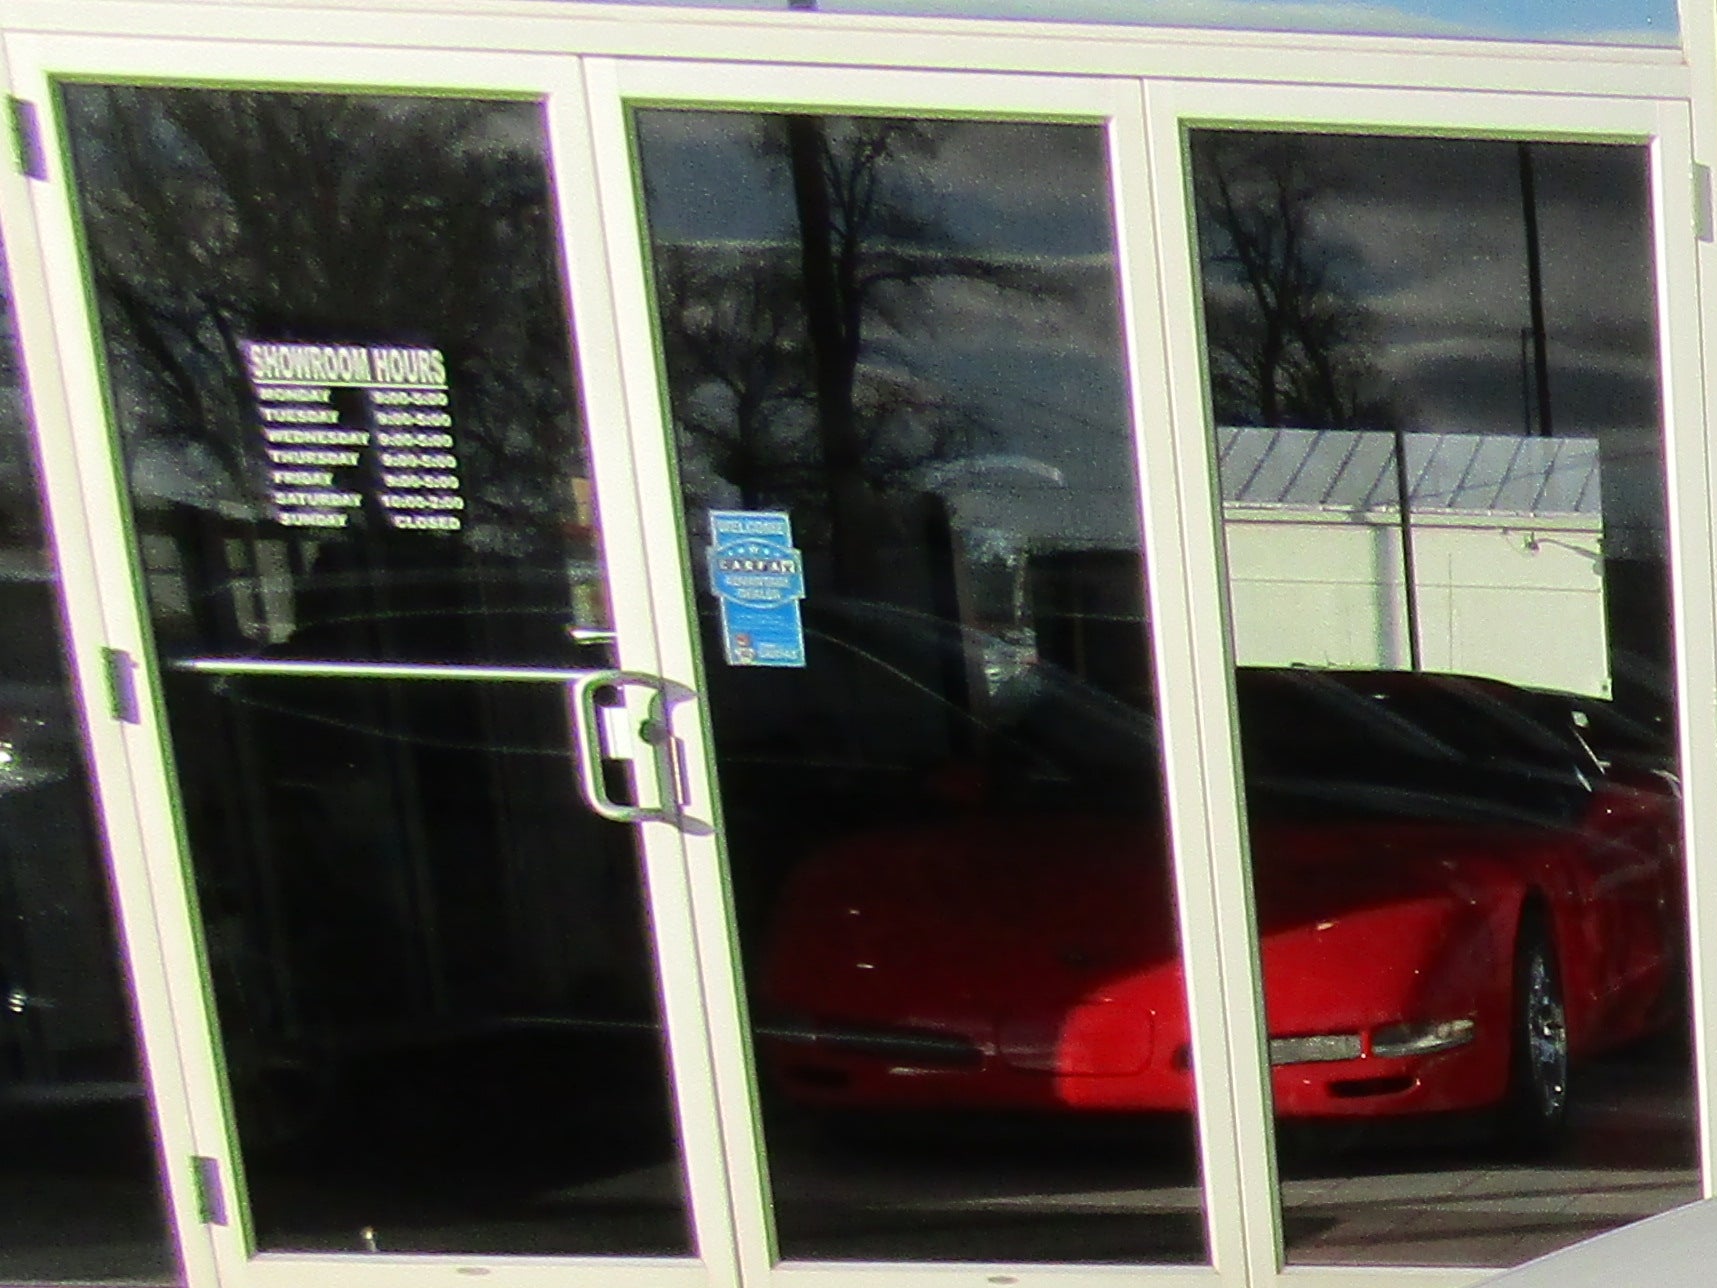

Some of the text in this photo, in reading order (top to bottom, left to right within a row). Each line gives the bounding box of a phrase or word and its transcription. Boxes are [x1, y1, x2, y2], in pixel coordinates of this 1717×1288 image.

[250, 344, 447, 385] SHOWROOM HOURS
[262, 408, 340, 424] TUESDAY
[266, 429, 370, 446] WEDNESDAY
[268, 450, 360, 466] THURSDAY
[272, 471, 334, 486] FRIDAY
[272, 491, 363, 507] SATURDAY
[277, 512, 462, 530] SUNDAY CLOSED
[718, 559, 796, 573] CARFAX
